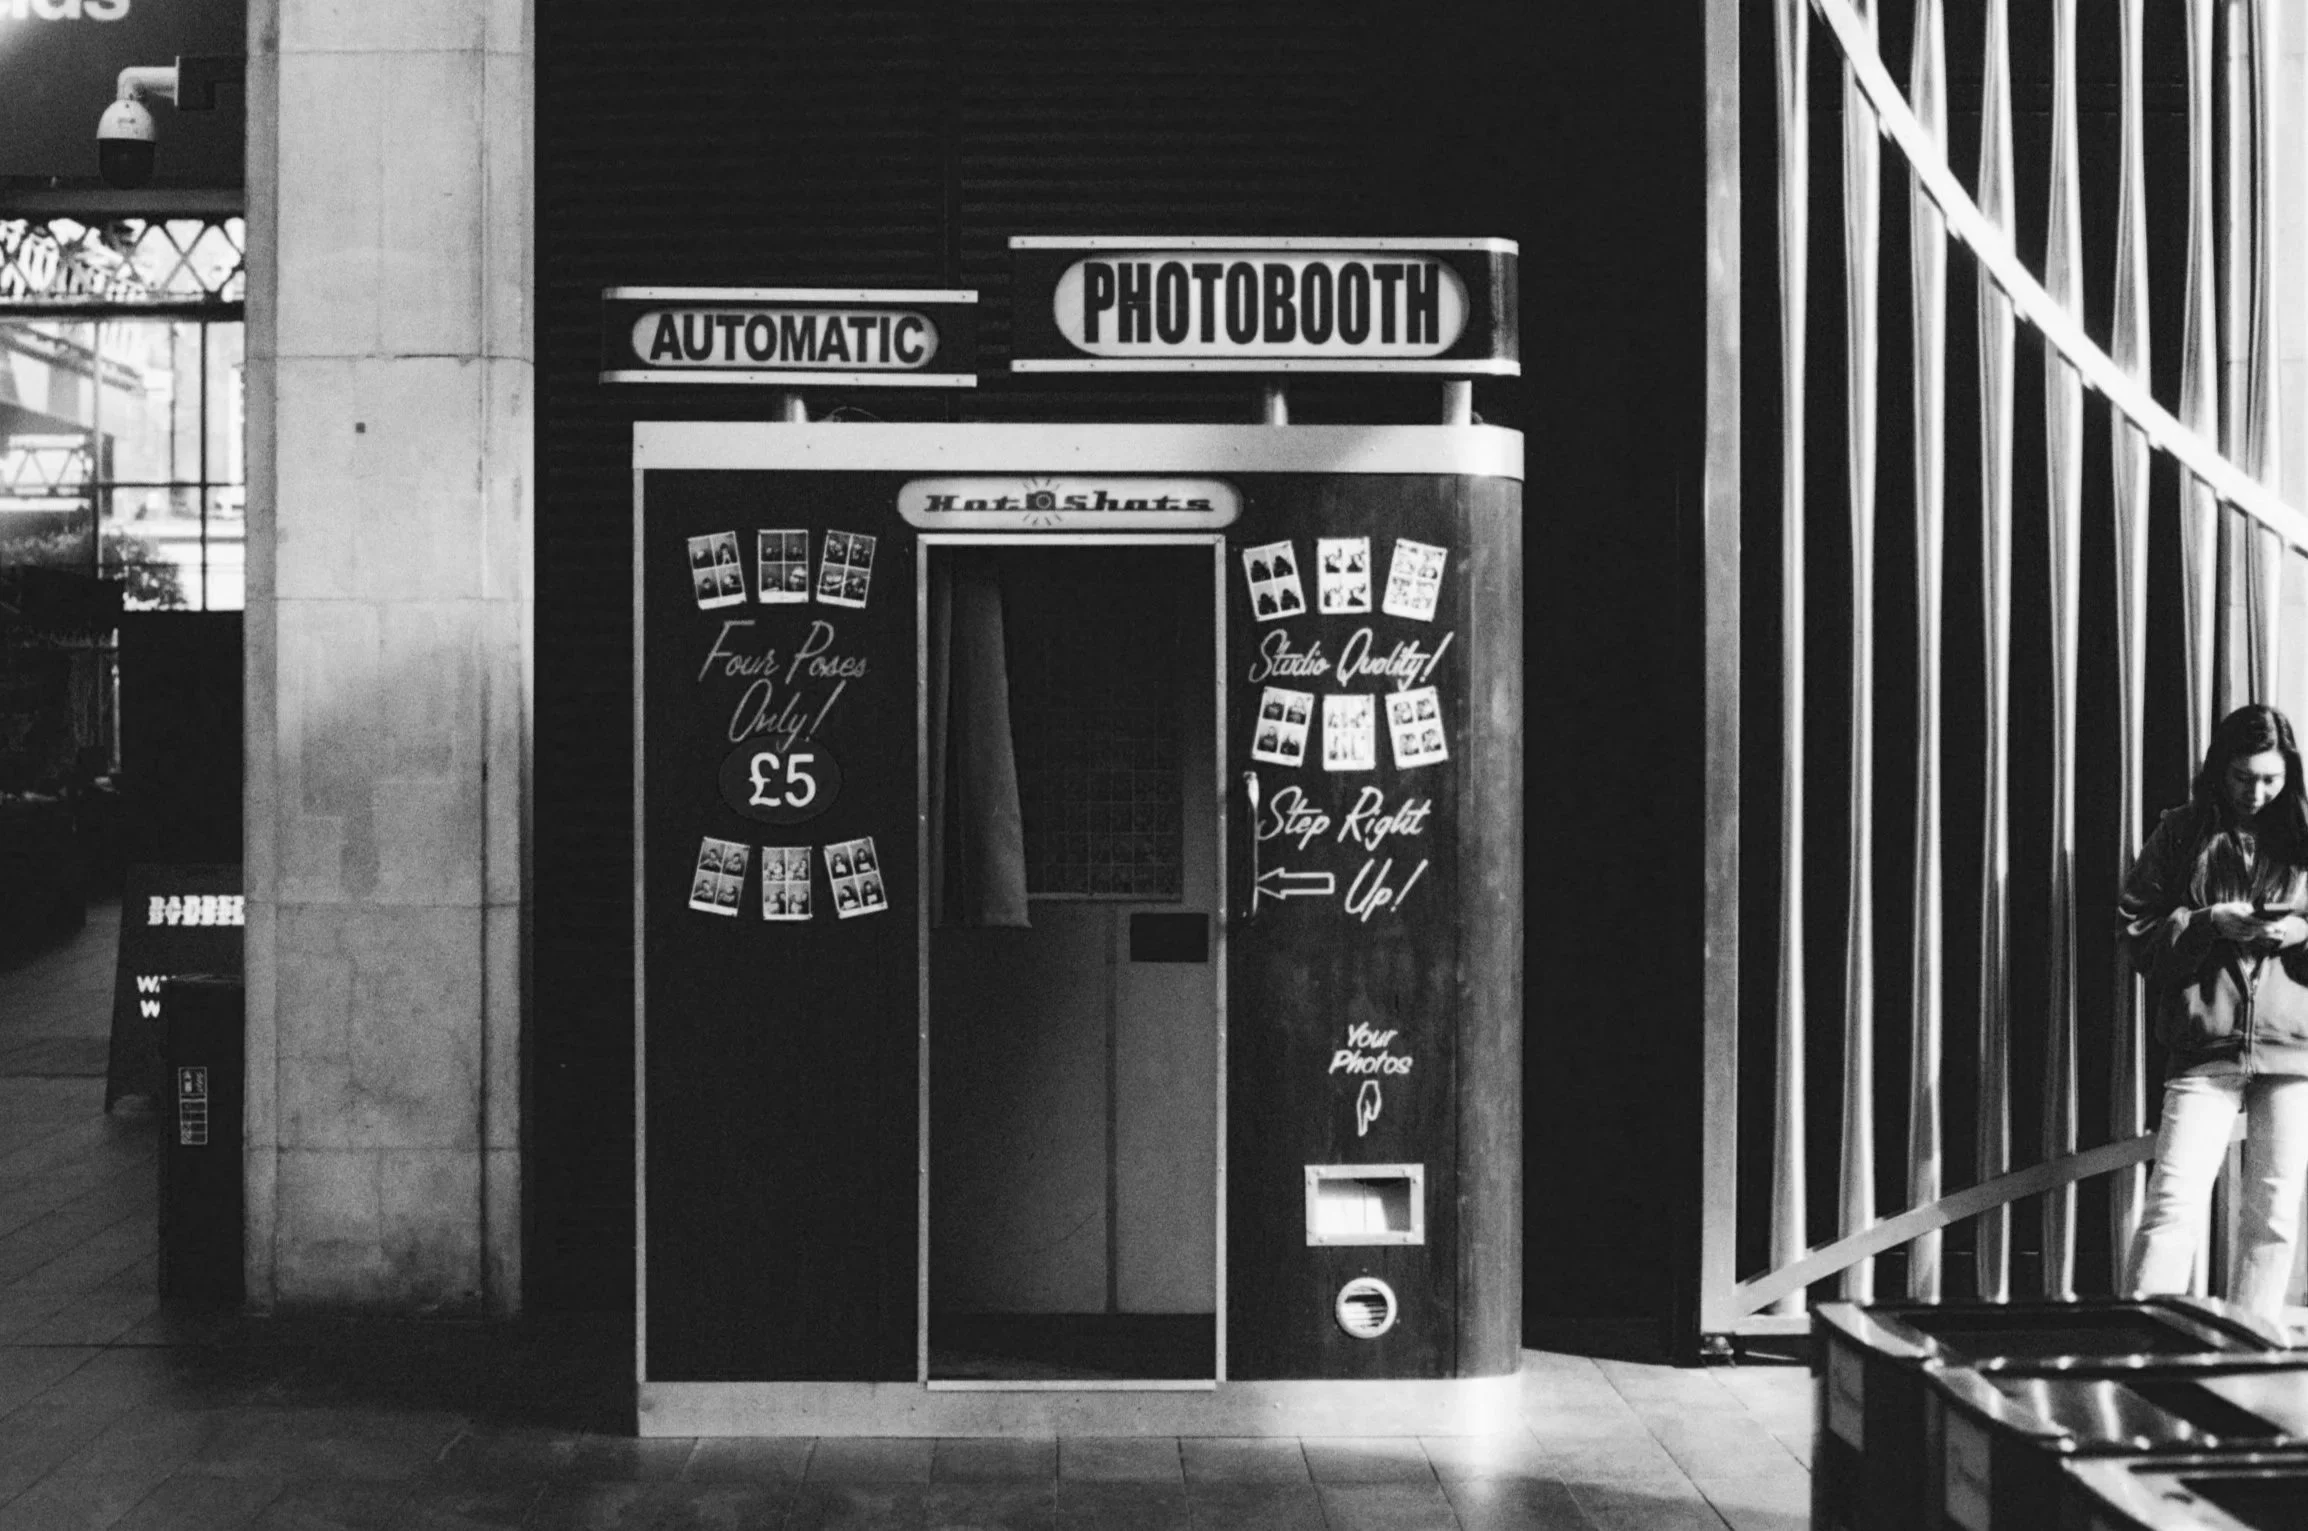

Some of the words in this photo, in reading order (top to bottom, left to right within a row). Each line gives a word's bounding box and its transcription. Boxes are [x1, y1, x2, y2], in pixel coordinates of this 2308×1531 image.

[1083, 260, 1441, 345] PHOTOBOOTH
[649, 312, 926, 365] AUTOMATIC
[923, 494, 1019, 513] Hot
[1063, 490, 1214, 513] Shots
[697, 619, 781, 682] Four
[784, 619, 867, 685] Poses
[1249, 628, 1330, 683] Studio
[1336, 627, 1455, 691] Quality!
[728, 677, 847, 753] Only!
[748, 751, 817, 808] £5
[1256, 785, 1331, 851] Step
[1336, 786, 1432, 852] Right
[1344, 857, 1429, 923] Up!
[1328, 1048, 1414, 1075] Photos
[1347, 1021, 1399, 1049] Your
